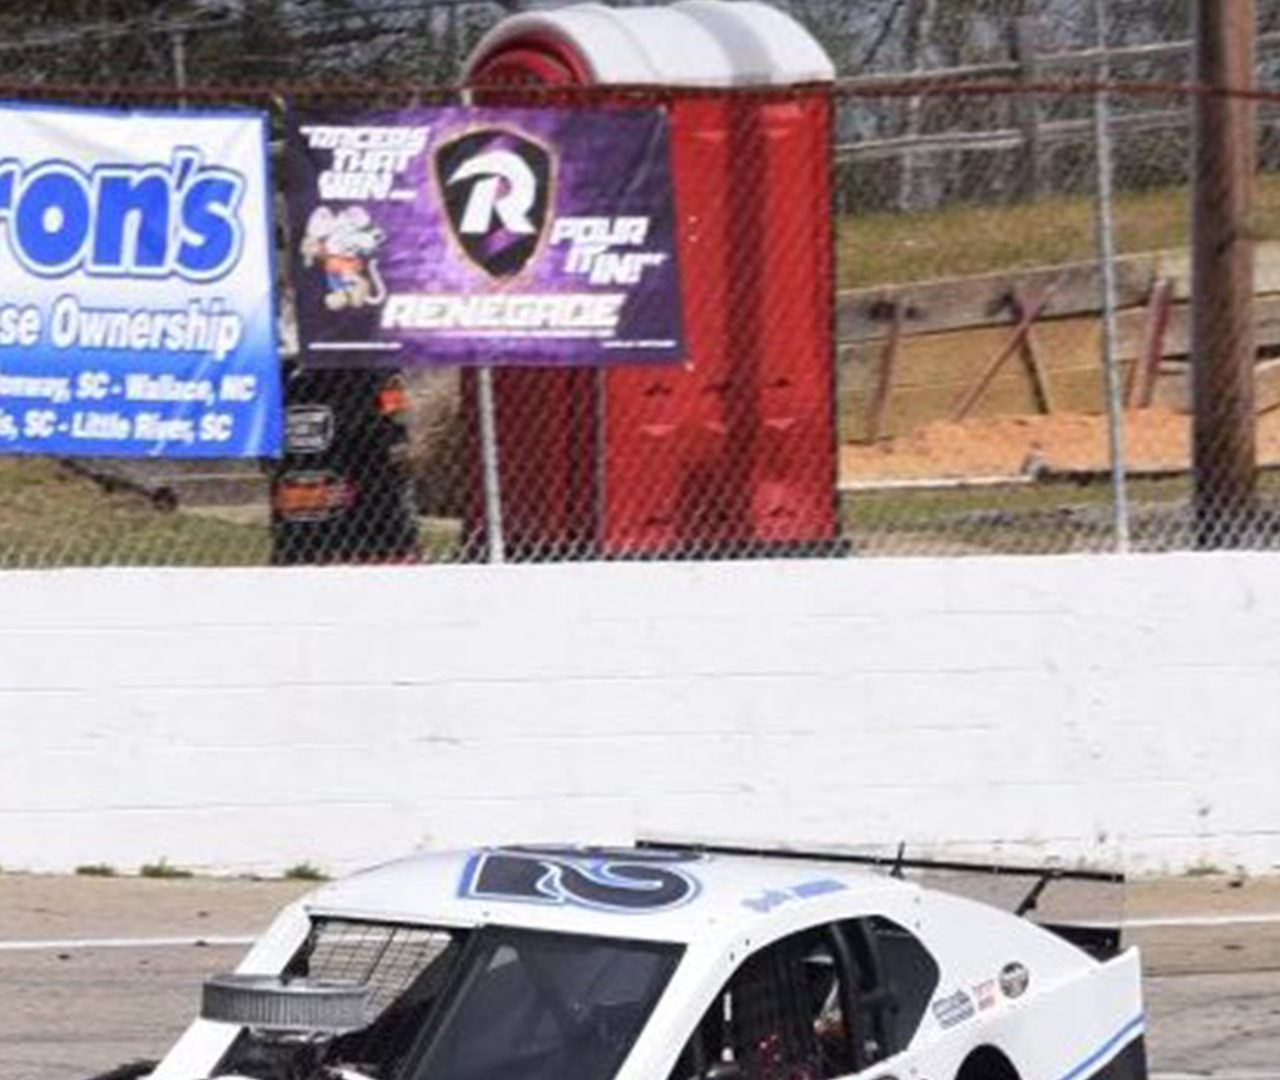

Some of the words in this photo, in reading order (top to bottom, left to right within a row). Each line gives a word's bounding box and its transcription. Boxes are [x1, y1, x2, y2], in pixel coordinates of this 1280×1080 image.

[447, 149, 536, 234] R
[550, 217, 651, 246] POUR
[565, 239, 609, 273] IT
[51, 294, 242, 360] Ownership
[381, 293, 627, 328] RENEGADE
[76, 371, 110, 399] SC
[125, 373, 216, 406] Wallace,
[220, 374, 257, 400] NC
[23, 410, 57, 438] SC
[71, 411, 131, 440] Little
[200, 413, 234, 441] SC
